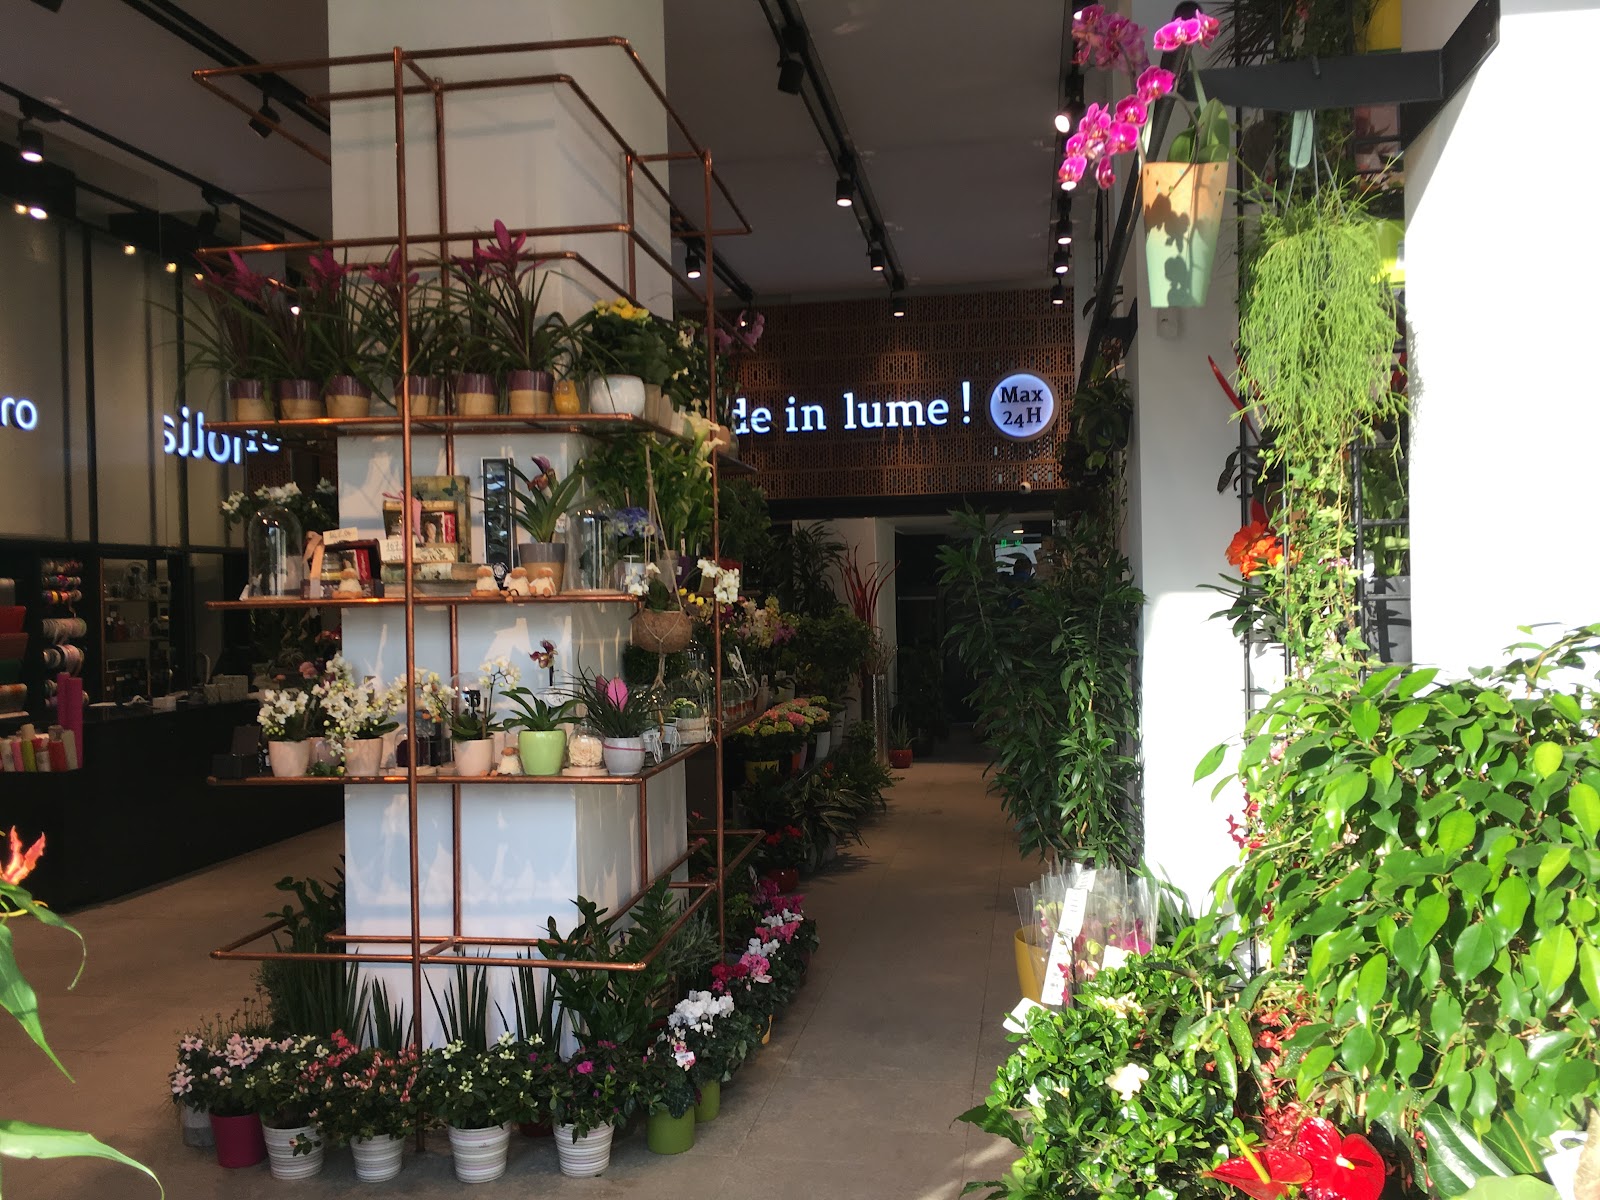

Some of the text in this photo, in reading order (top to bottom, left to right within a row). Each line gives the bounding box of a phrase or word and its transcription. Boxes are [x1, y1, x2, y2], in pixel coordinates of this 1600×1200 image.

[1000, 386, 1044, 404] Max
[785, 396, 827, 433] in
[843, 392, 950, 430] lume
[1002, 406, 1042, 428] 24H
